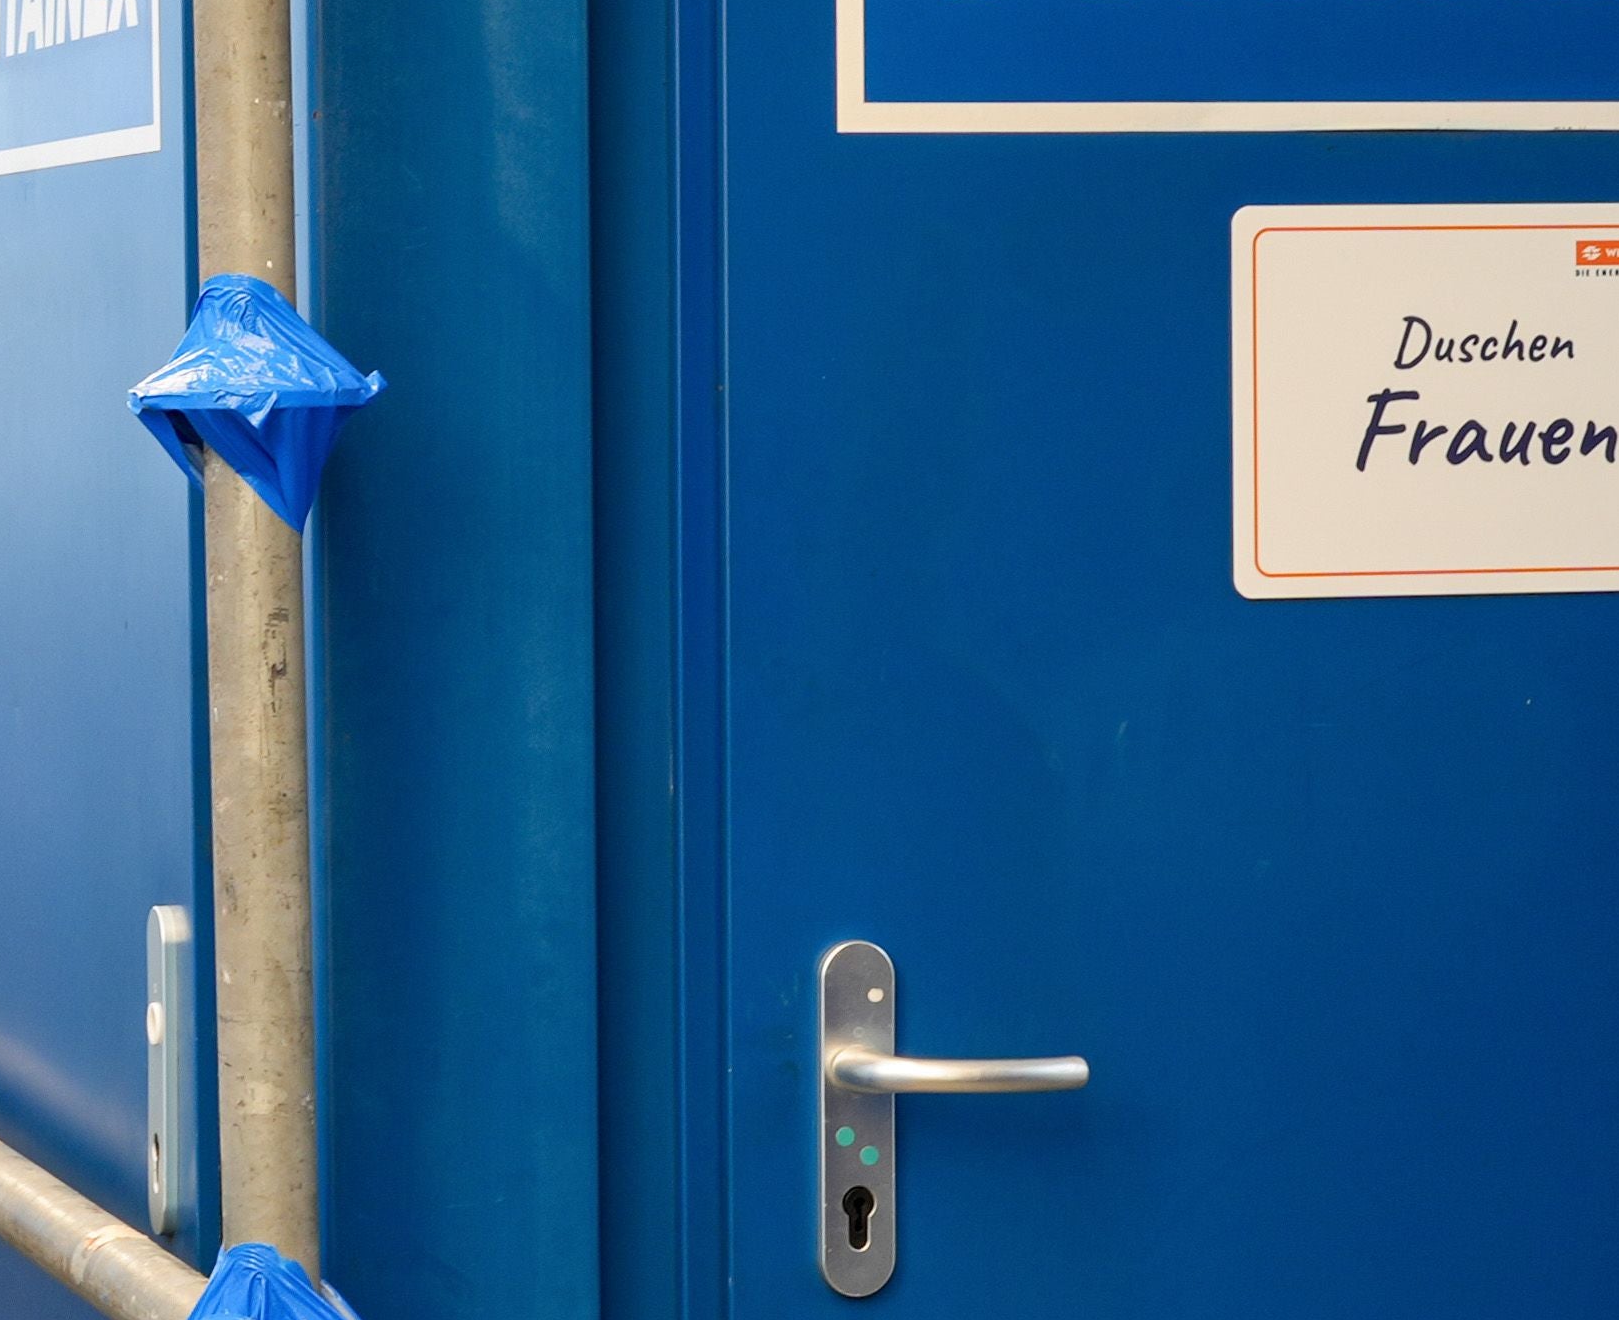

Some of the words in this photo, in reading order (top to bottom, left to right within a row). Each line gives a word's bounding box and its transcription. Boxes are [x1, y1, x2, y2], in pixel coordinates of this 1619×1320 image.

[1575, 269, 1590, 277] DIE
[1393, 315, 1575, 370] Duschen
[1356, 387, 1618, 473] Frauen
